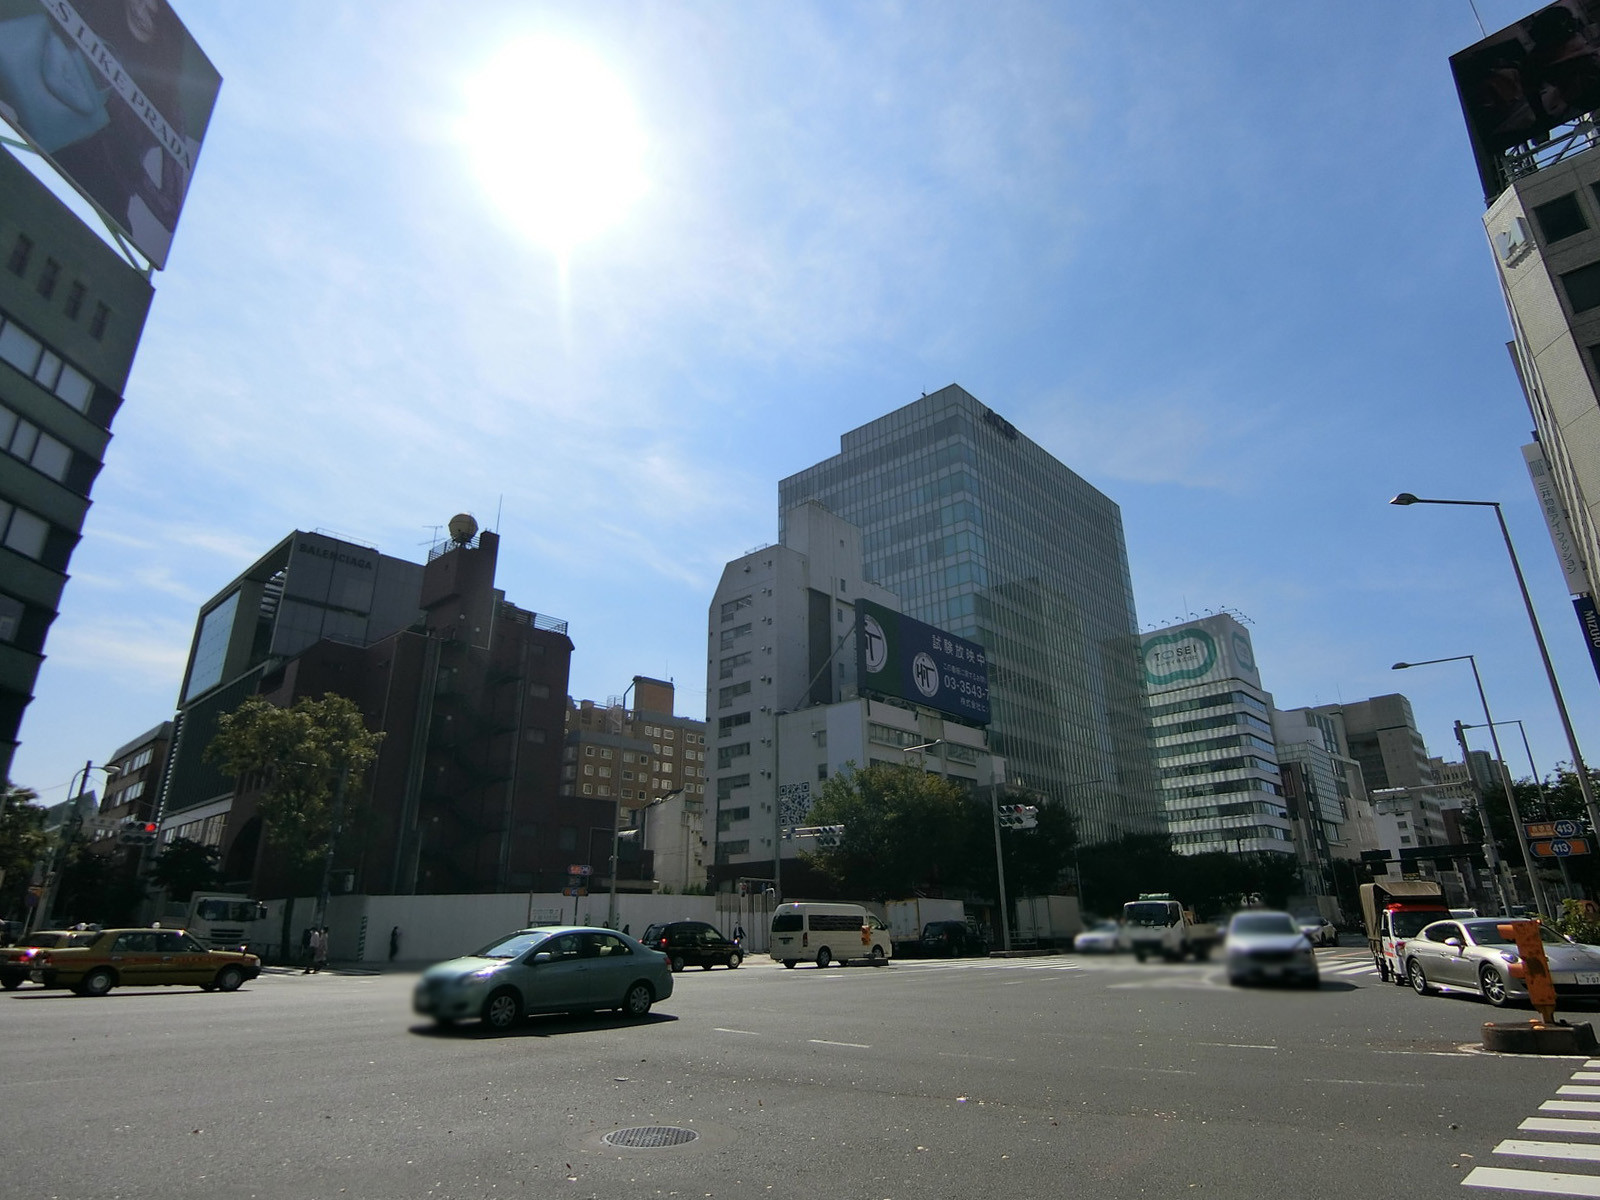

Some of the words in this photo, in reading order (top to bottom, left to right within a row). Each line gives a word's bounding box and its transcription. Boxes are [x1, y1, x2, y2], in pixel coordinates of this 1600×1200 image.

[77, 26, 127, 91] LIKE
[131, 91, 191, 170] PRADA
[299, 543, 373, 571] BALENCIAGA
[931, 634, 986, 667] 試験放映中
[1154, 644, 1197, 661] TOSEI
[1557, 824, 1572, 833] 413
[1553, 843, 1568, 852] 413
